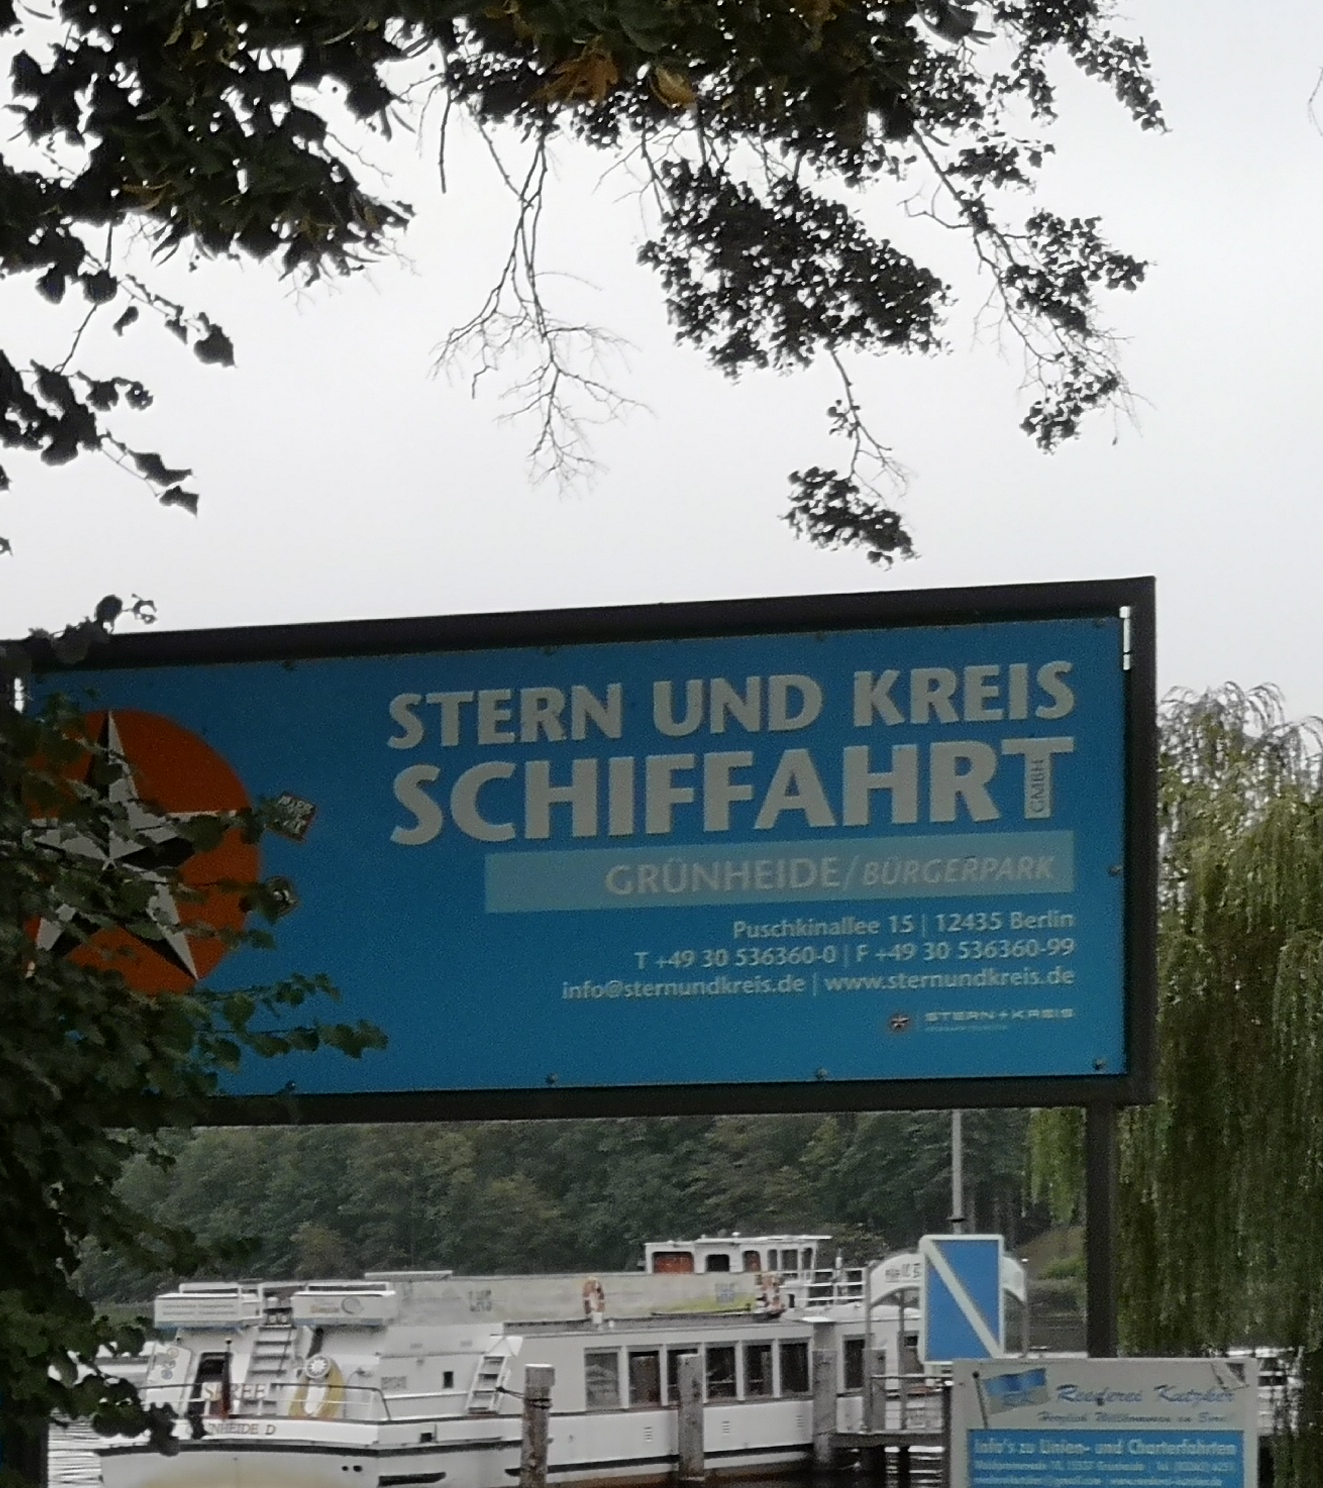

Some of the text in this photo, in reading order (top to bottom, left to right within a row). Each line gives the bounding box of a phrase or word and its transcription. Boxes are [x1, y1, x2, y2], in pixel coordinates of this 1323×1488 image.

[387, 661, 1075, 749] STERN UND KREIS
[389, 736, 1075, 846] SCHIFFAHRT
[733, 915, 881, 939] Puschkinallee
[888, 914, 914, 934] 15
[935, 911, 1002, 933] 12435
[1009, 909, 1076, 930] Berlin
[633, 951, 650, 970] T
[655, 950, 696, 969] +49
[701, 948, 730, 968] 30
[734, 944, 837, 967] 536360-0
[856, 944, 869, 963] F
[875, 942, 918, 961] +49
[923, 941, 951, 962] 30
[957, 937, 1076, 960] 536360-99
[560, 973, 806, 1000] info@sternundkreis.de
[824, 965, 1076, 991] www.sternundkreis.de
